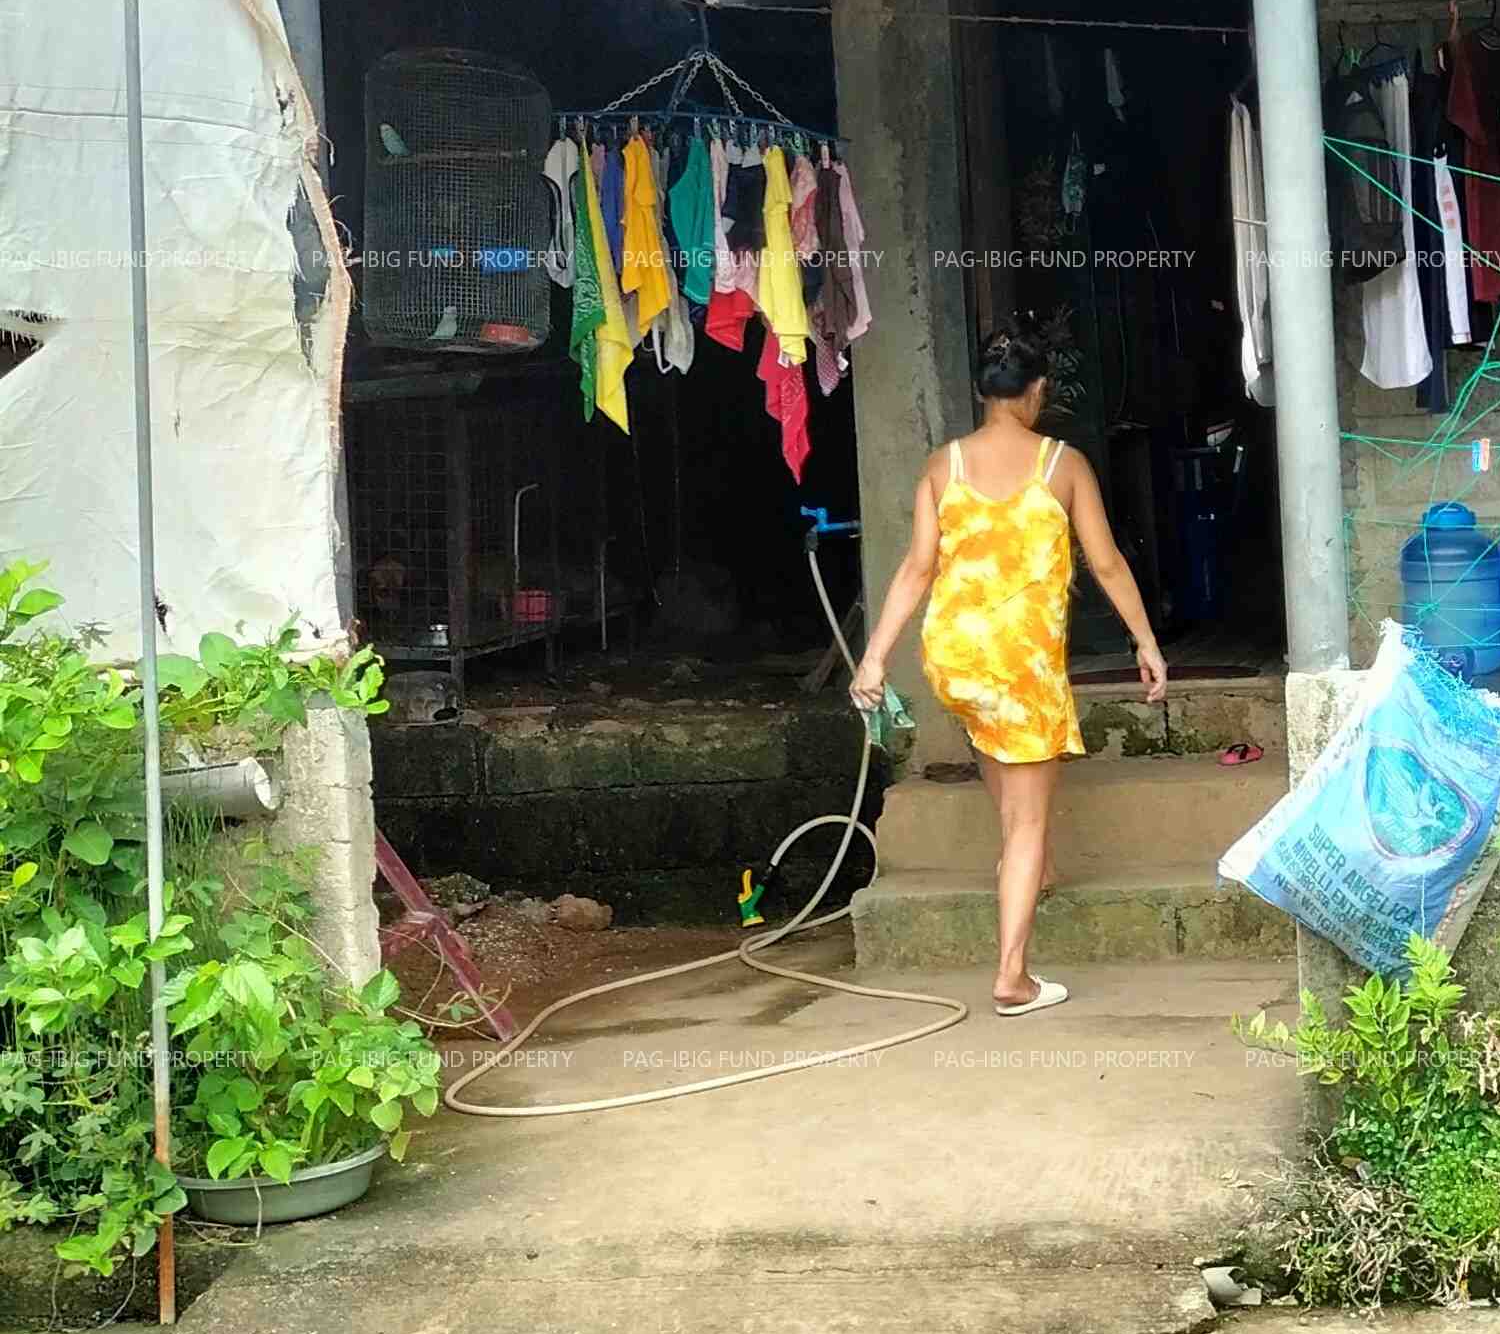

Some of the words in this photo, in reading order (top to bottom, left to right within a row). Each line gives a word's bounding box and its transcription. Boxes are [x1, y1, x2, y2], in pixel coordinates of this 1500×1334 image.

[1271, 871, 1300, 899] NET
[1352, 943, 1374, 963] 25
[1308, 823, 1346, 873] SUPER
[1342, 869, 1418, 927] ANGELICA
